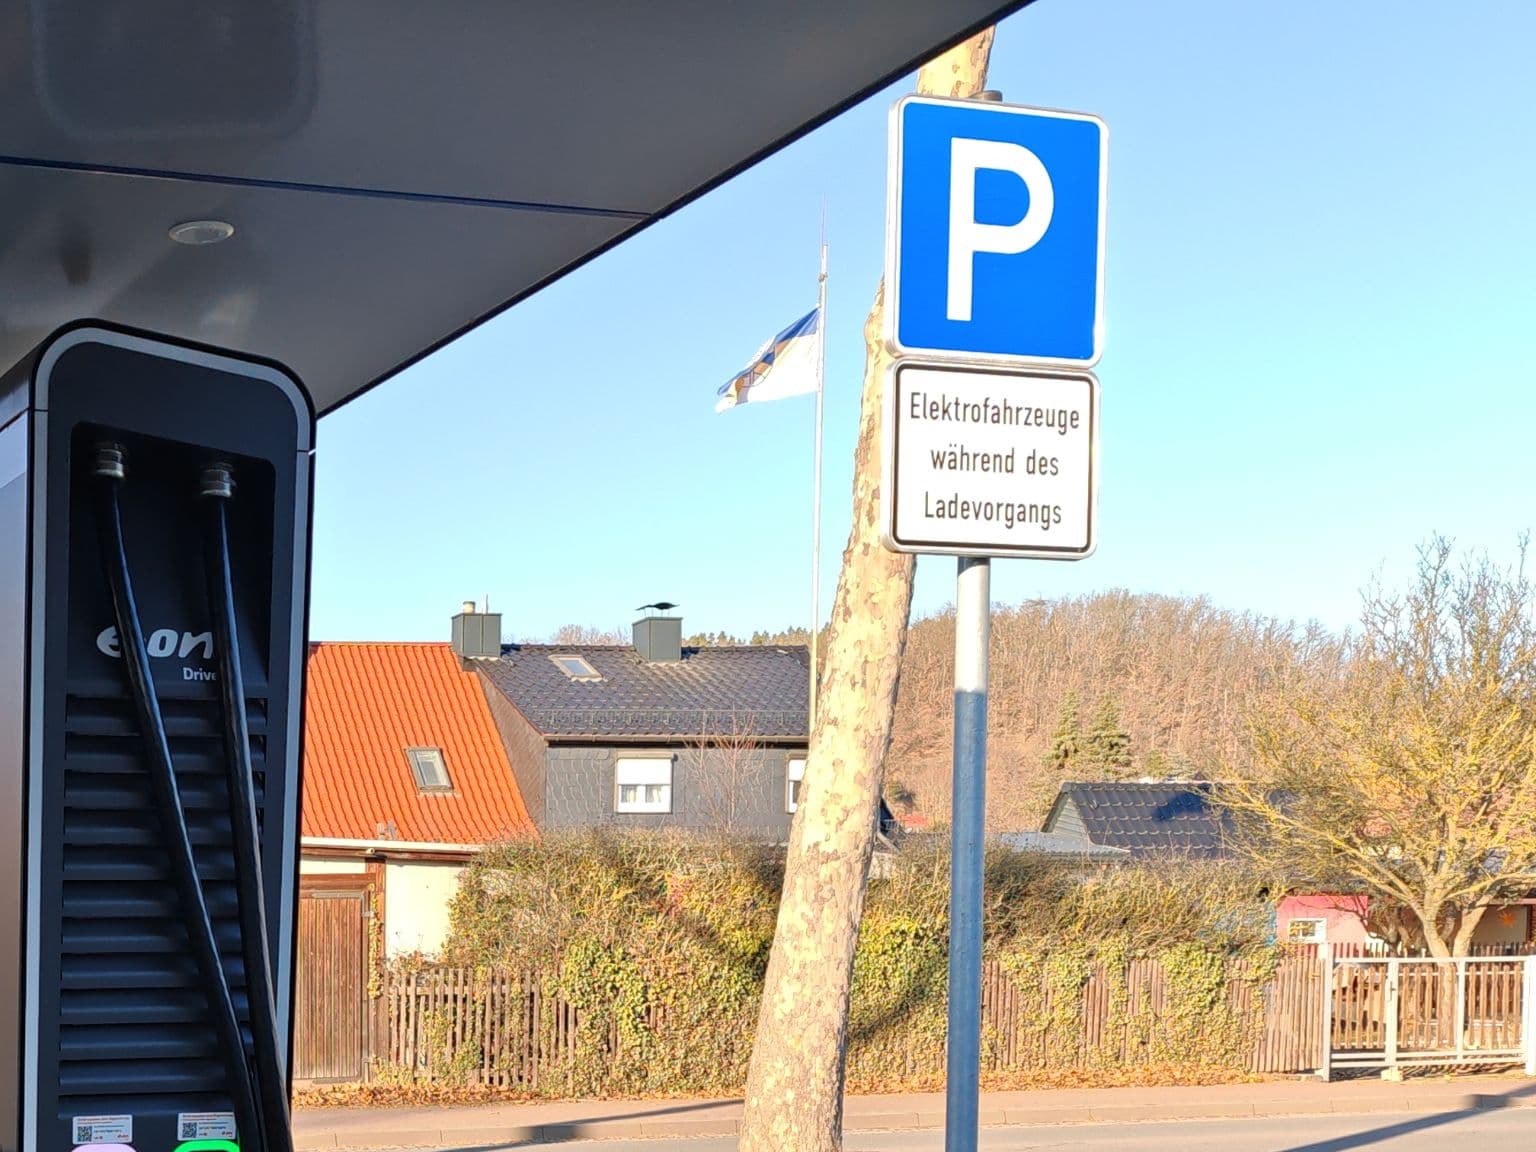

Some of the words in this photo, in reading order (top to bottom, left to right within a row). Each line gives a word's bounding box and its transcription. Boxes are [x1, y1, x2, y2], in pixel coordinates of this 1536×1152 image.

[946, 137, 1054, 321] P
[910, 392, 1080, 435] Elektrofahrzeuge
[930, 445, 1015, 474] während
[1026, 453, 1060, 476] des
[924, 491, 1062, 530] Ladevorgangs
[182, 667, 217, 681] Drive
